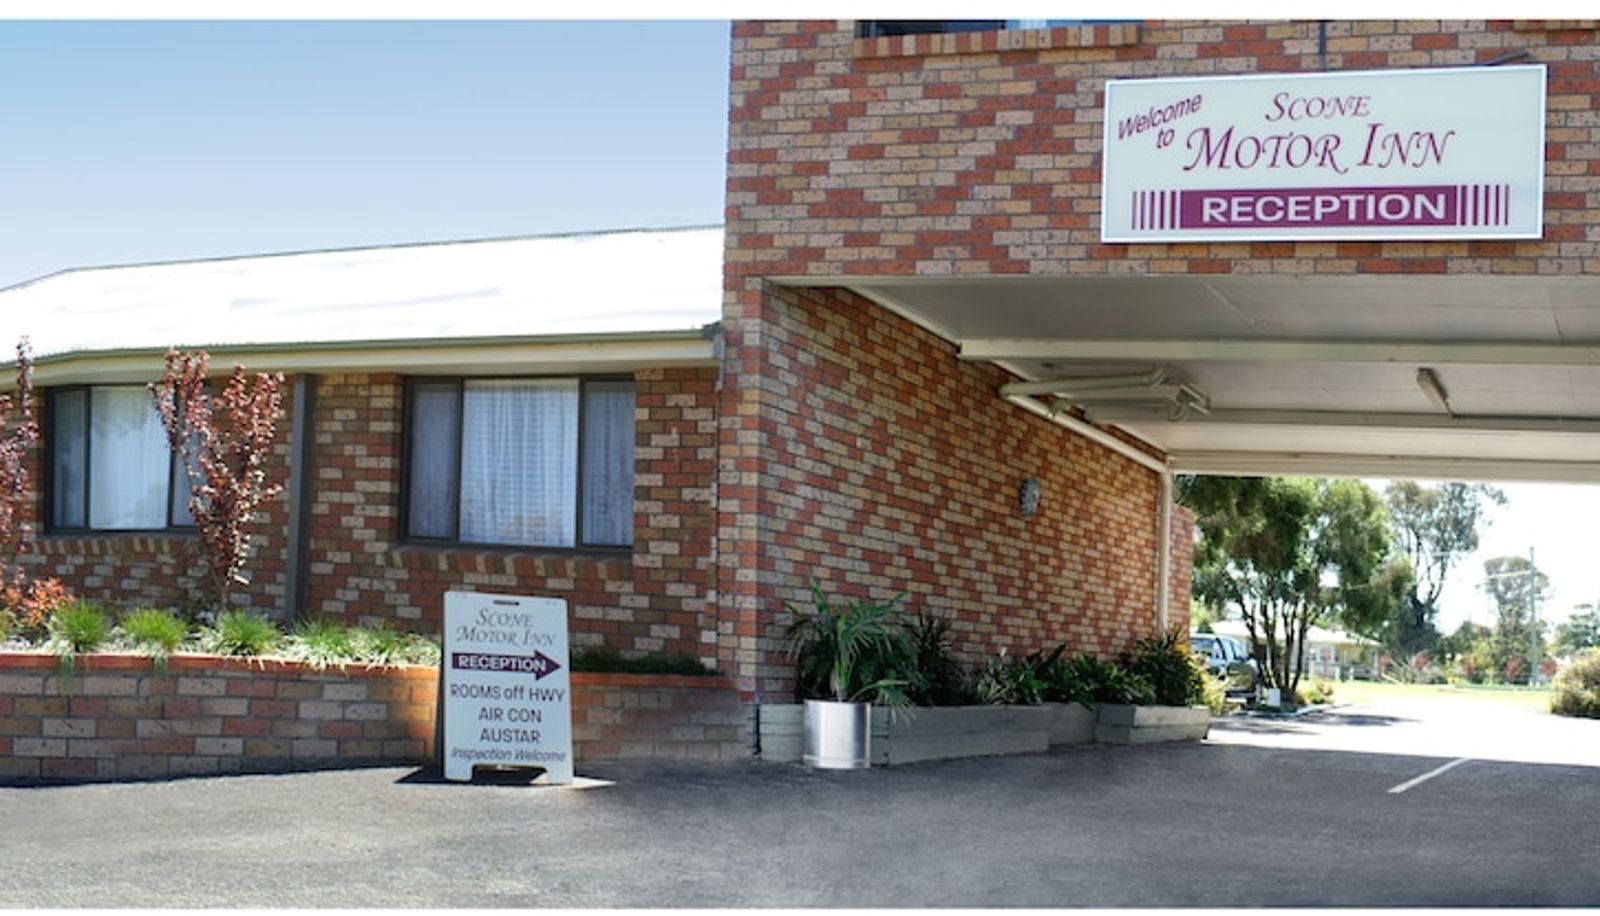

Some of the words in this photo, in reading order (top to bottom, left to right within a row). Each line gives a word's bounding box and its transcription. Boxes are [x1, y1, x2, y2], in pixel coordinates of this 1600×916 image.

[1265, 92, 1372, 122] SCONE
[1117, 94, 1202, 140] Welcome
[1156, 126, 1175, 149] to
[1182, 125, 1349, 174] MOTOR
[1357, 122, 1456, 168] INN
[1201, 193, 1446, 223] RECEPTION
[476, 608, 534, 627] SCONE
[456, 626, 519, 645] MOTOR
[522, 629, 557, 646] INN
[458, 655, 546, 672] RECEPTION
[451, 684, 503, 700] ROOMS
[504, 686, 525, 700] off
[529, 688, 565, 702] HWY
[478, 707, 503, 721] AIR
[508, 708, 542, 722] CON
[480, 728, 541, 744] AUSTAR
[515, 748, 566, 762] Welcome
